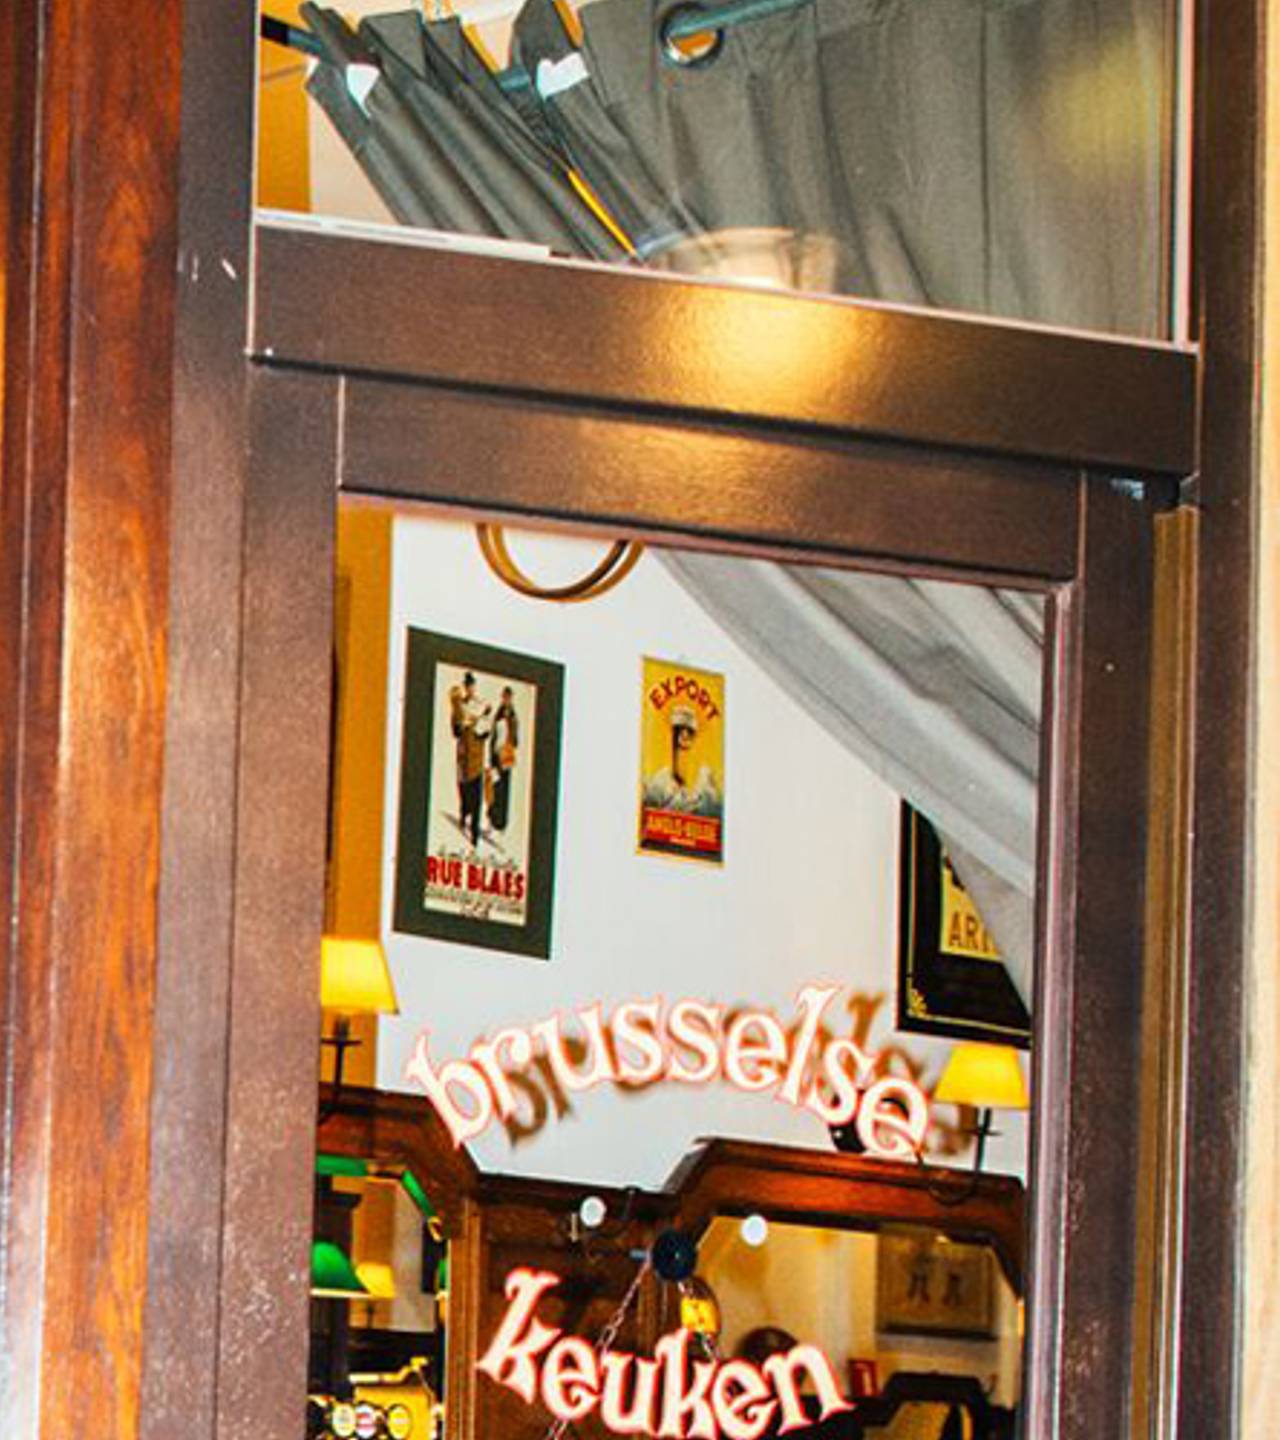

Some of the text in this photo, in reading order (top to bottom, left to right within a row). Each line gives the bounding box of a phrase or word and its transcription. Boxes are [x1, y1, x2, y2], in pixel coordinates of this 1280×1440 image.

[649, 675, 719, 722] EXPORT
[427, 856, 462, 887] RUE
[468, 864, 524, 900] BLAES
[406, 979, 931, 1158] brusselse
